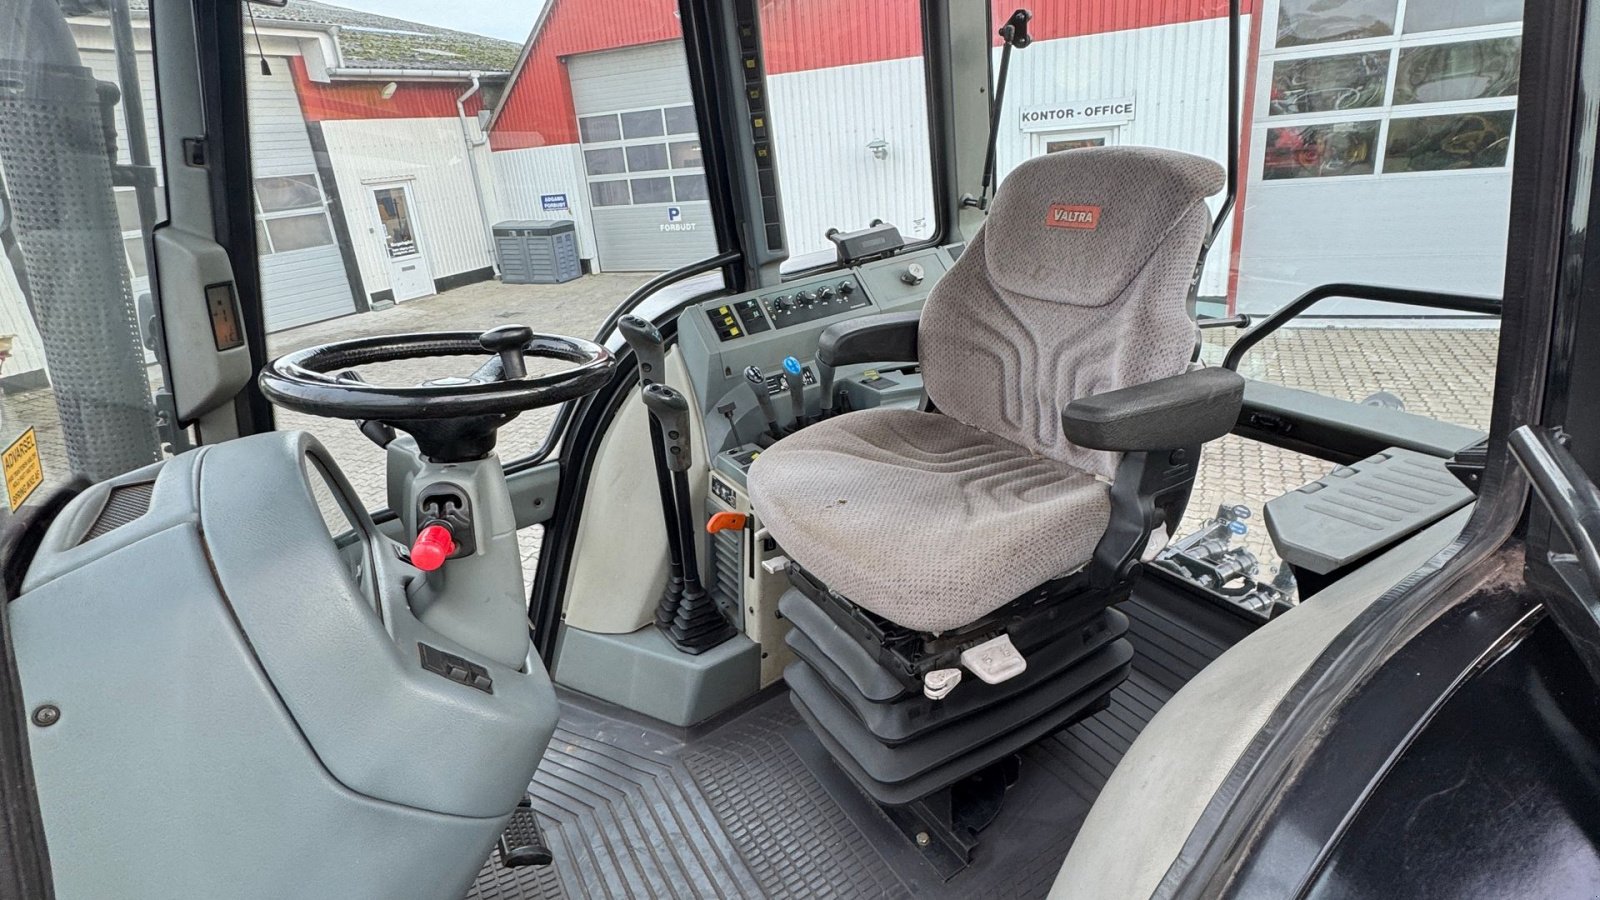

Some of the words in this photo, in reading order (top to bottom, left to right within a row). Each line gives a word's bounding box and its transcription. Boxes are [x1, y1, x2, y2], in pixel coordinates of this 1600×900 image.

[1022, 109, 1074, 122] KONTOR
[1084, 103, 1133, 117] OFFICE
[668, 207, 680, 221] P
[1054, 209, 1093, 223] VALTRA
[660, 223, 696, 232] FORBUDT
